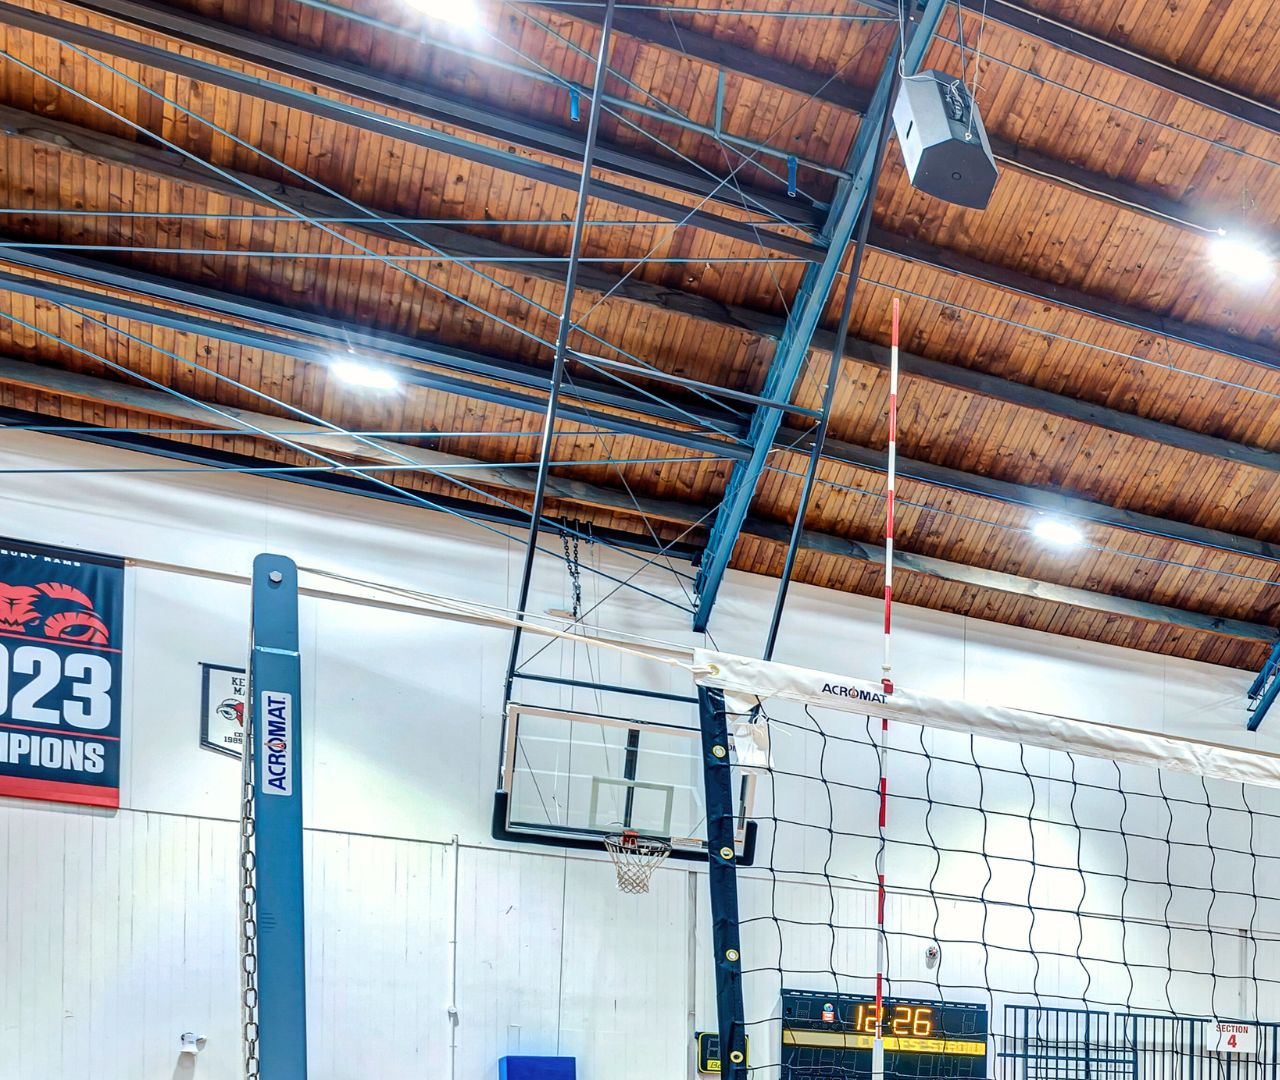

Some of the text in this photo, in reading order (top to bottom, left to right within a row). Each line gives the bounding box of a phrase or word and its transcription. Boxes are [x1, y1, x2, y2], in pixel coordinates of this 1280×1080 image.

[44, 556, 81, 567] RAMS
[0, 642, 112, 730] 23
[821, 683, 887, 704] ACROMAT
[266, 695, 287, 791] ACROMAT
[1215, 1024, 1249, 1034] SECTION
[1227, 1034, 1237, 1048] 4
